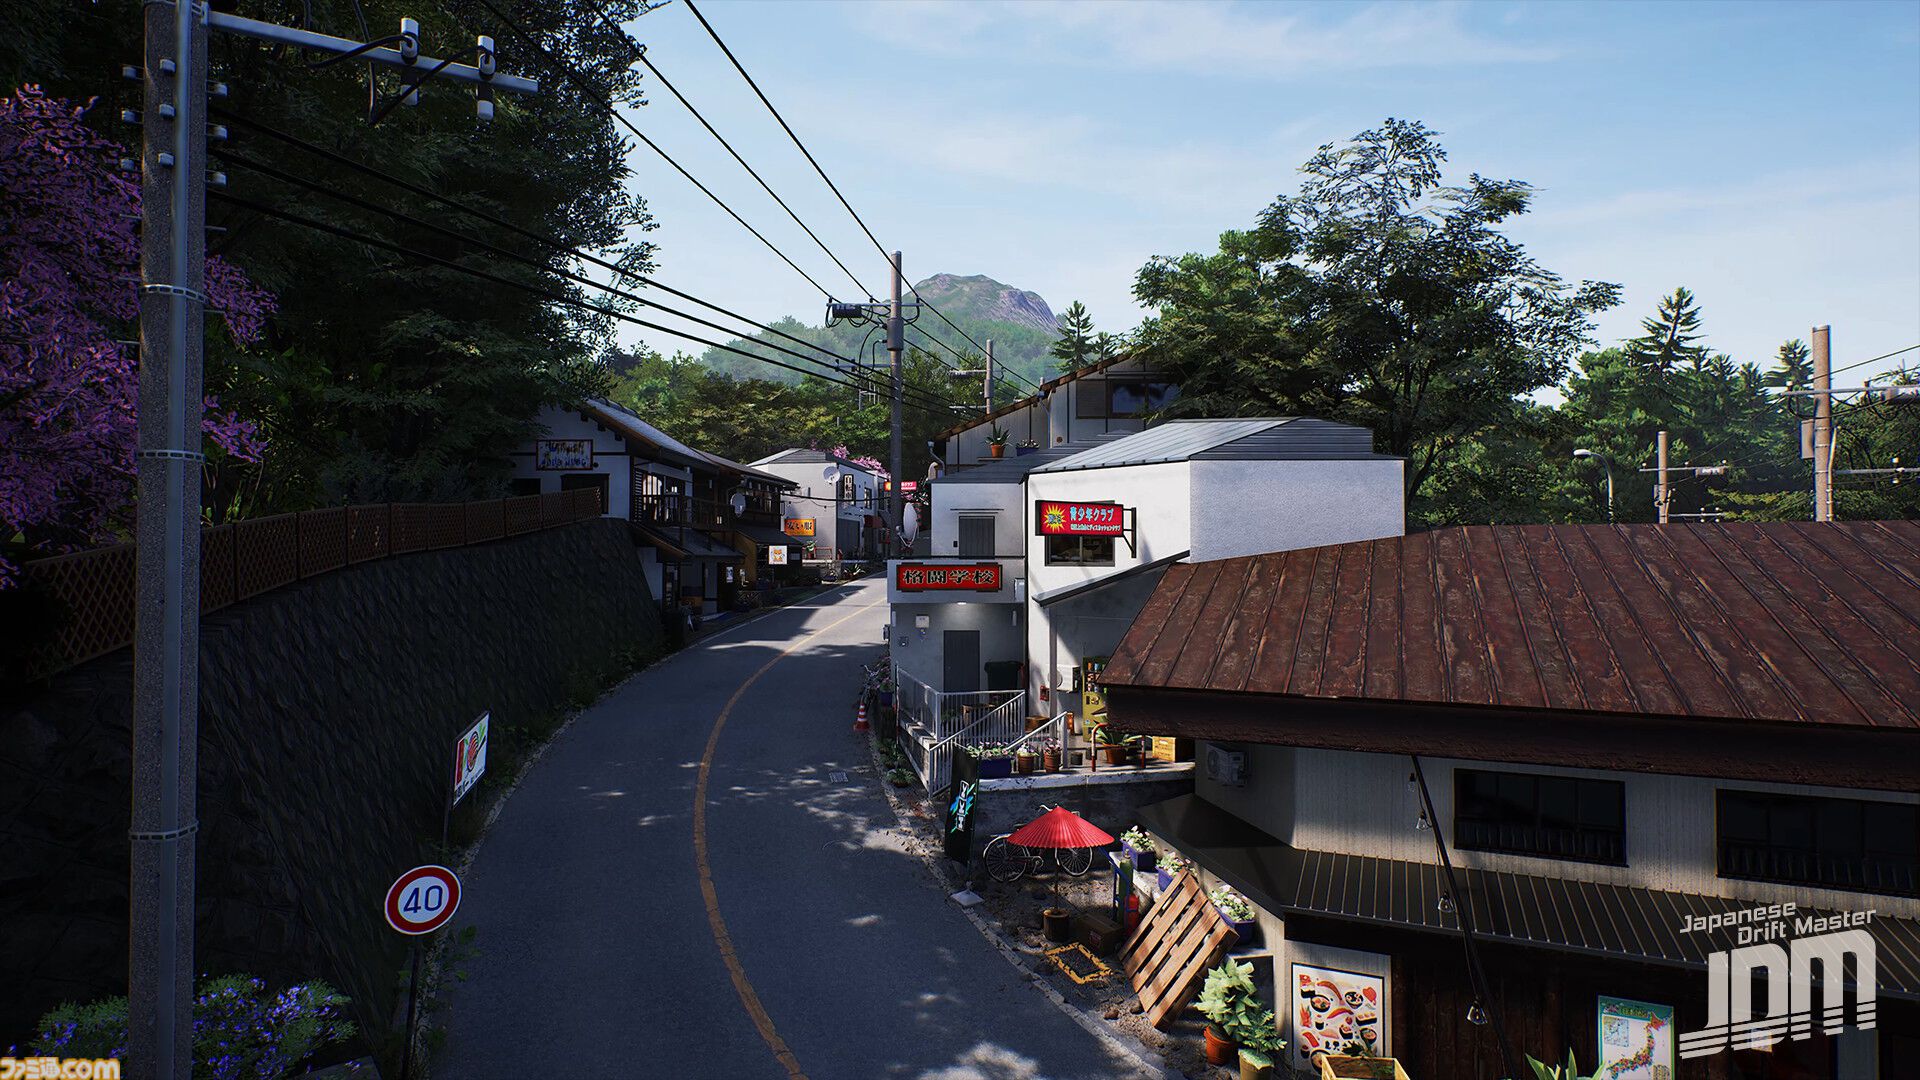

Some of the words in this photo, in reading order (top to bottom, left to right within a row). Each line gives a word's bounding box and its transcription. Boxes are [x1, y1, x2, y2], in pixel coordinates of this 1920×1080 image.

[1069, 505, 1114, 521] 青少年クラブ
[903, 569, 996, 584] 格闘学校
[403, 885, 443, 913] 40
